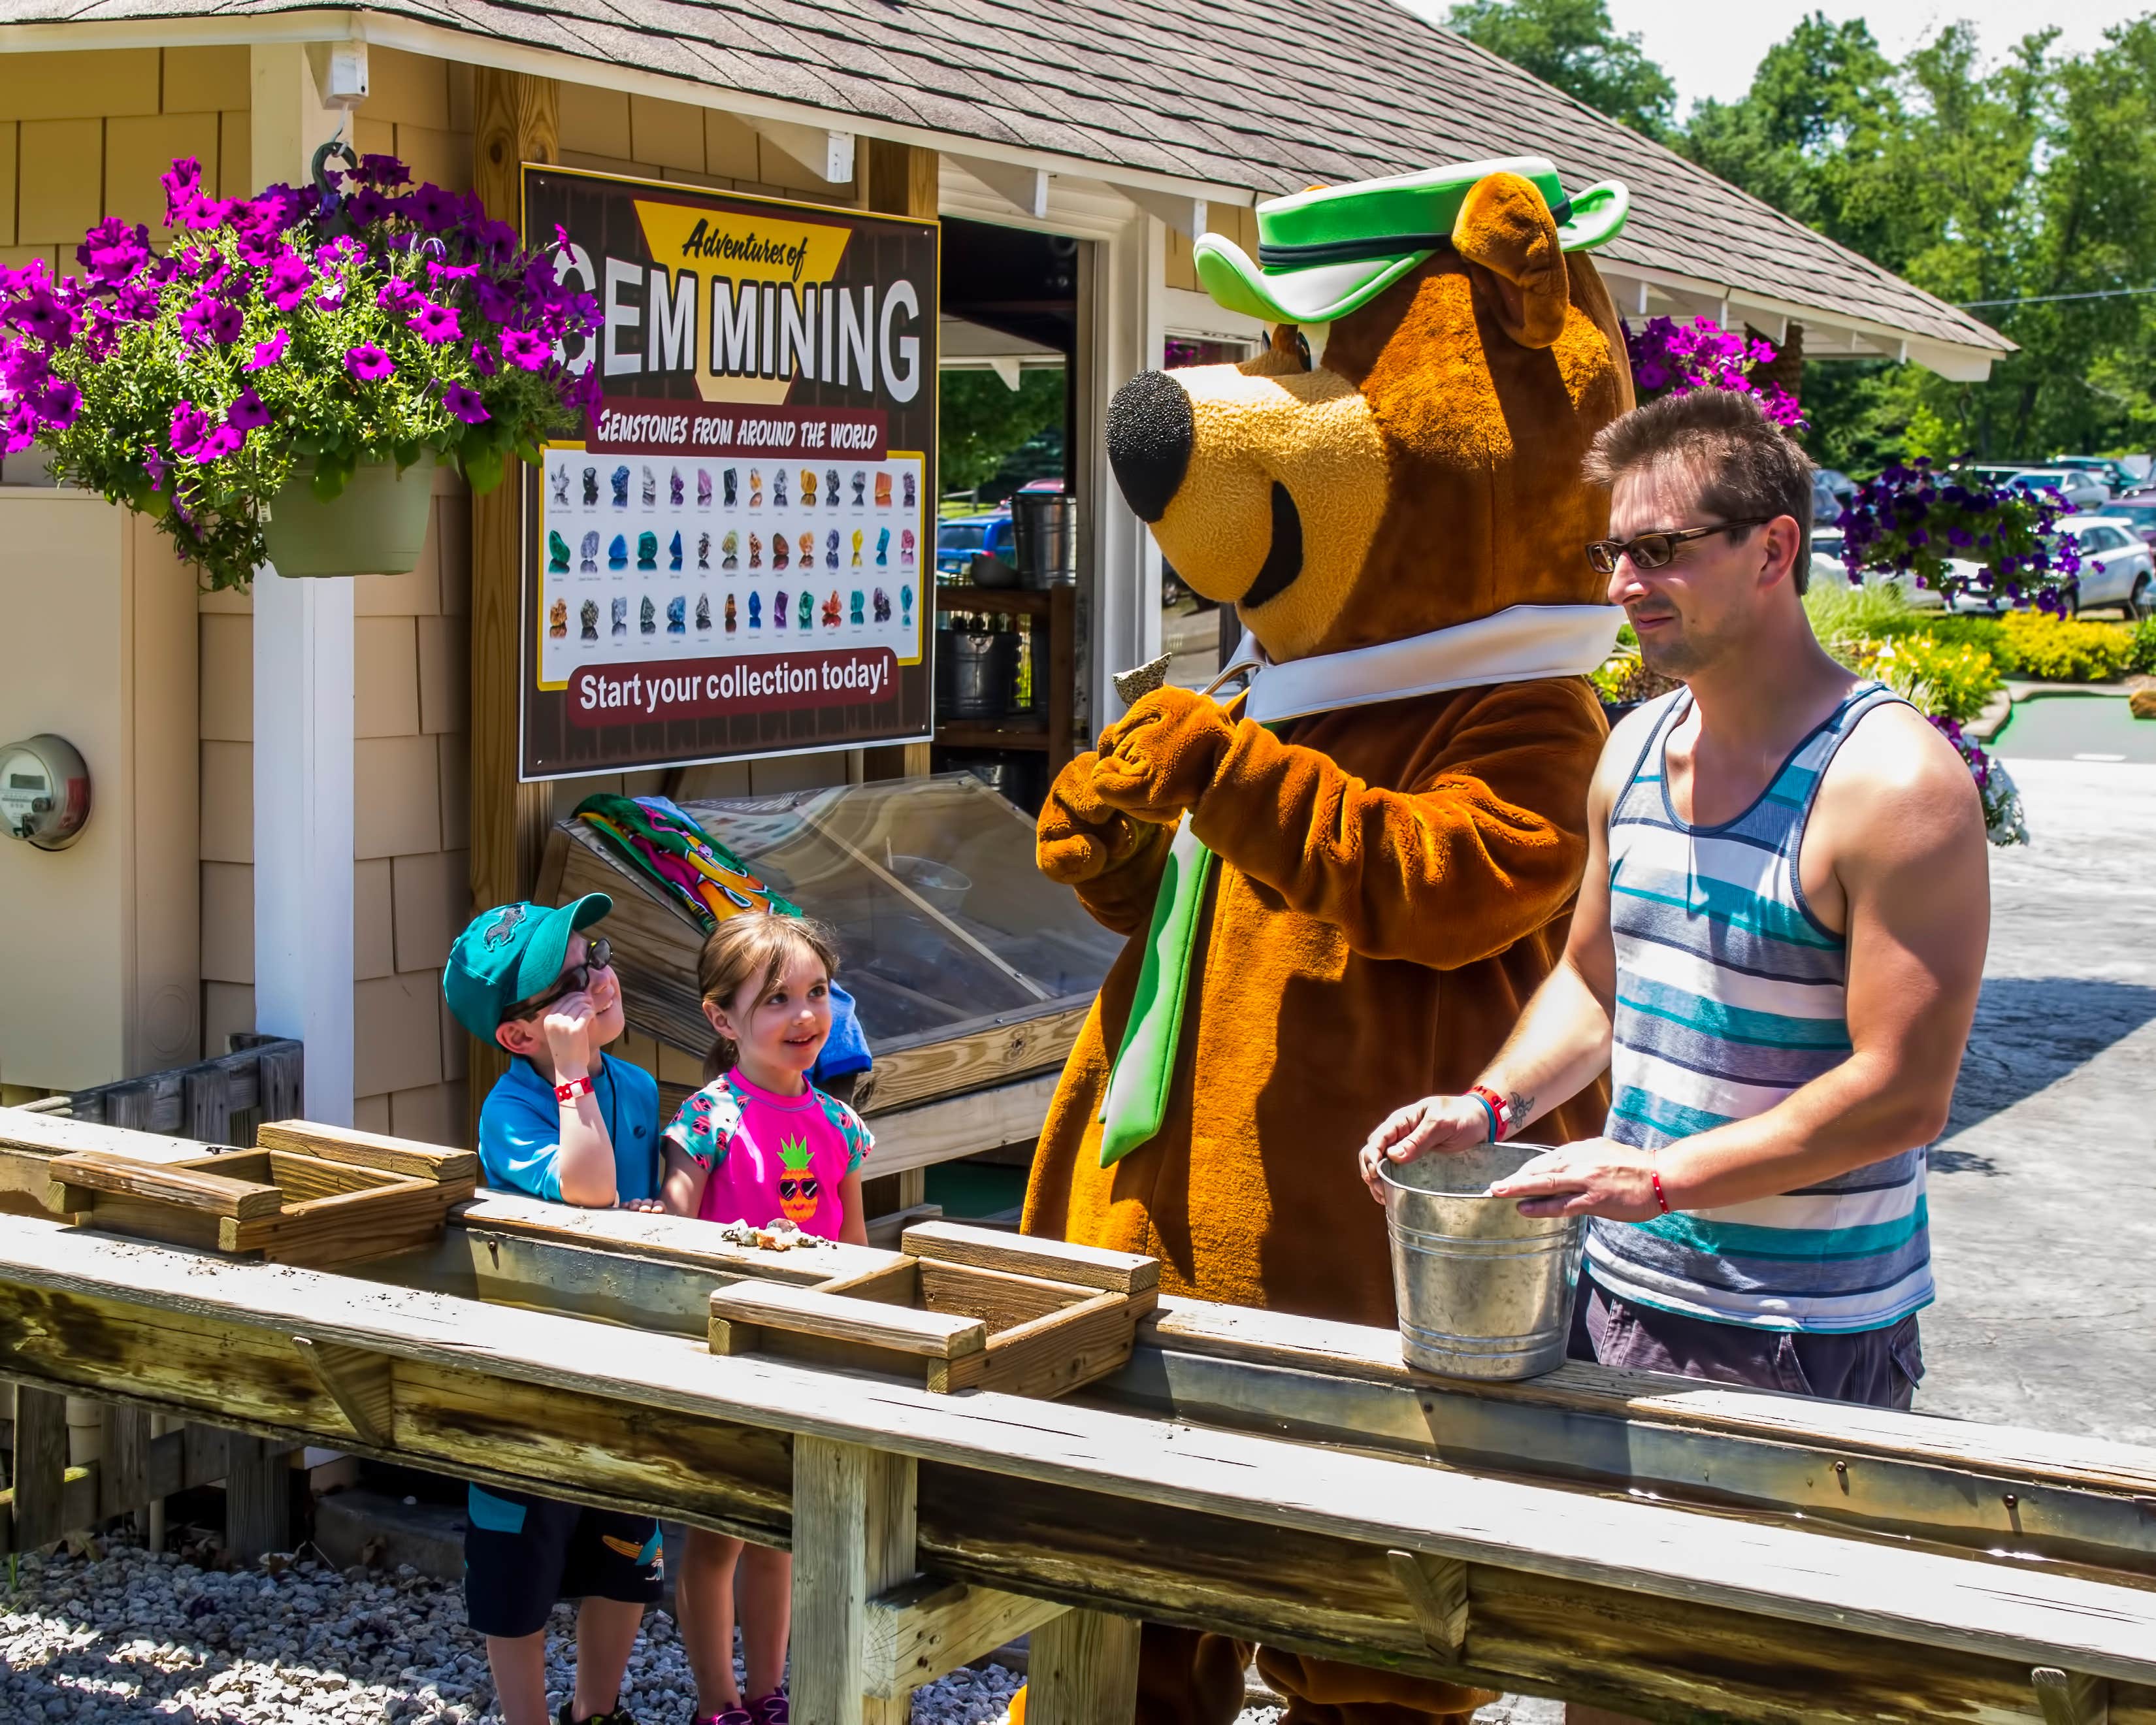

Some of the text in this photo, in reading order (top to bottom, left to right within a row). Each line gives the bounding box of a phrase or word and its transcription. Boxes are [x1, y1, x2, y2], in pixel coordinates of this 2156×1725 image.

[682, 218, 808, 282] Adventures of
[713, 280, 920, 403] MINING
[597, 408, 877, 450] GEMSTONES FROM AROUND THE WORLD
[580, 655, 888, 713] Start your collection today!
